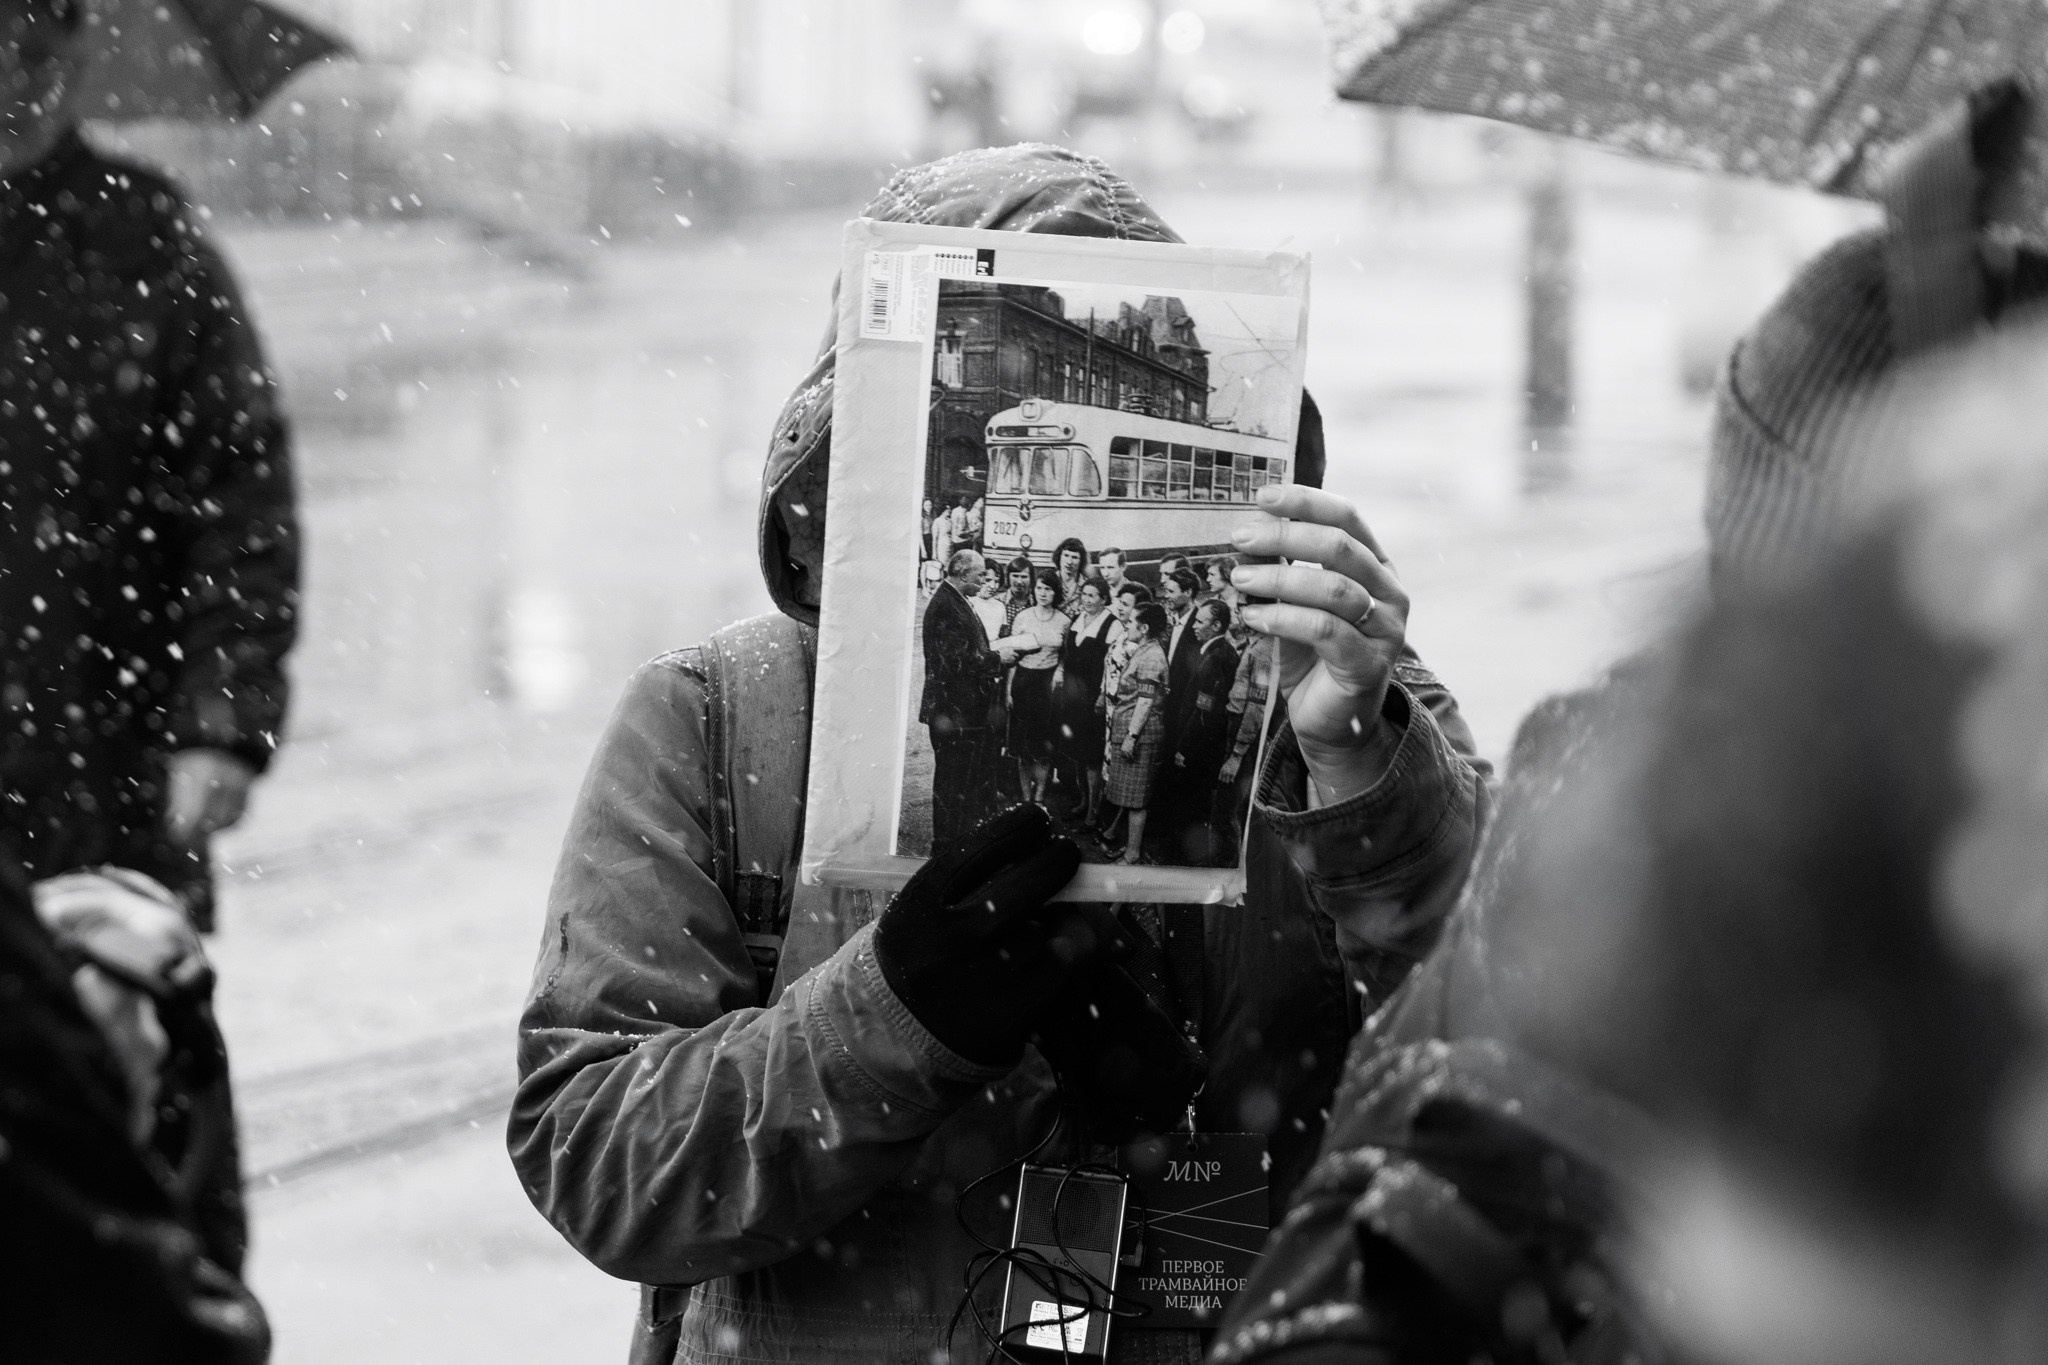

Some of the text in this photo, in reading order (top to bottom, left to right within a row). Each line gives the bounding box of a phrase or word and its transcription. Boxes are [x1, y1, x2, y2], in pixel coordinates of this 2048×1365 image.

[993, 521, 1018, 536] 2027
[1162, 1260, 1225, 1273] ПЕРВОЕ
[1138, 1274, 1248, 1291] ТРАМВАЙНОЕ
[1165, 1295, 1223, 1310] МЕДИА
